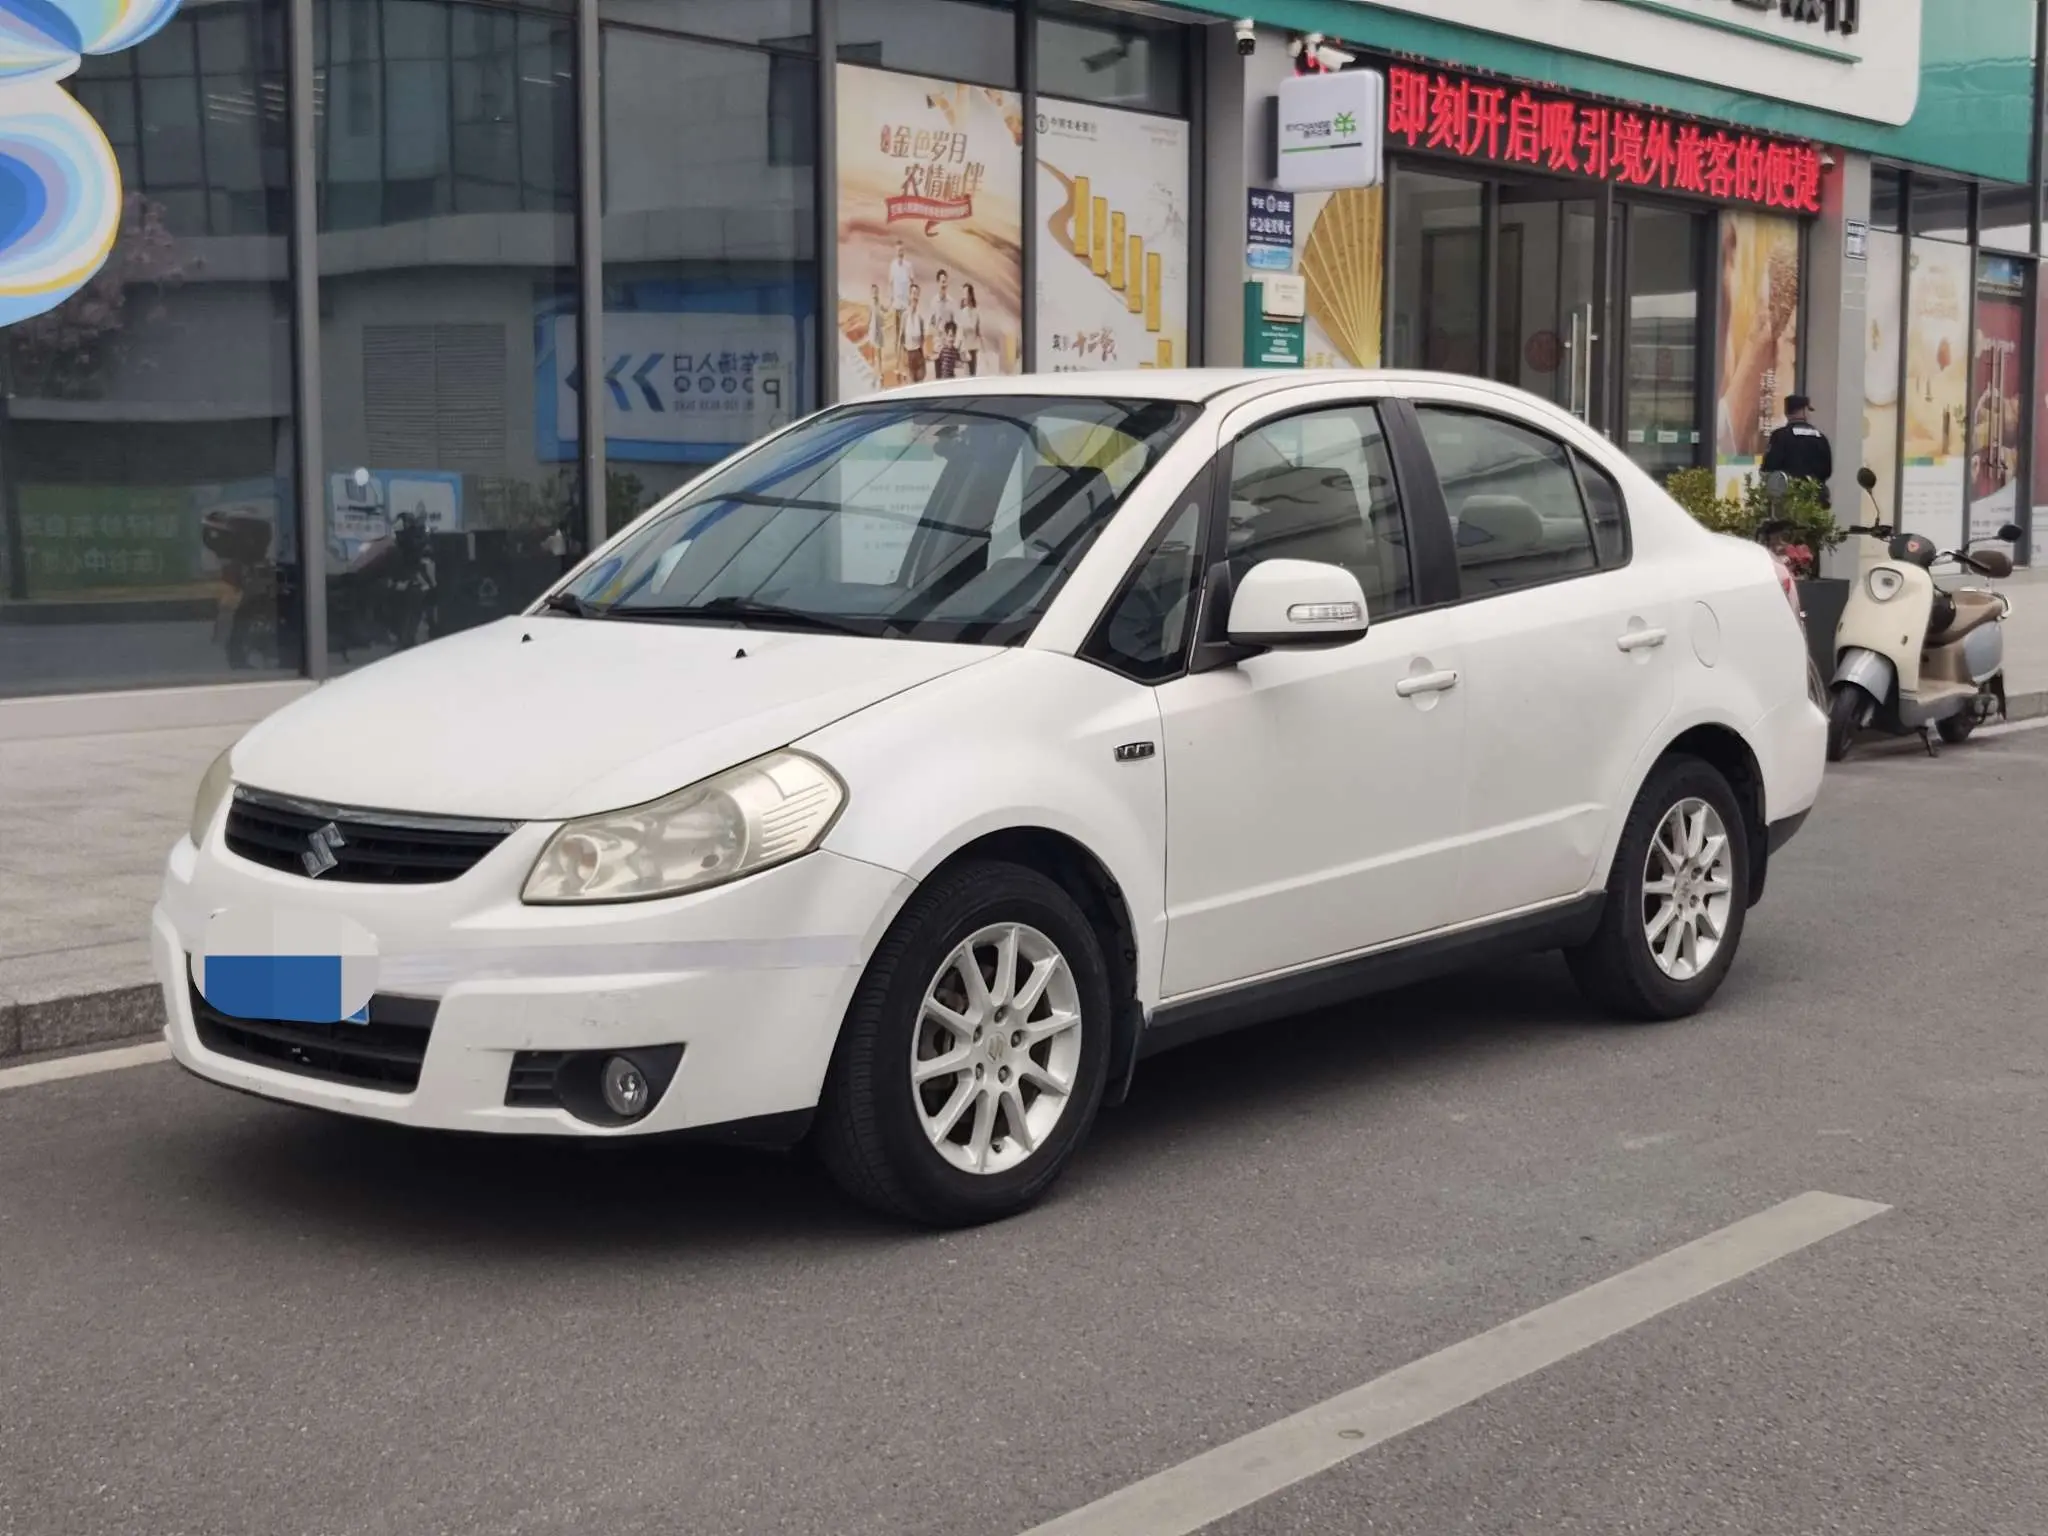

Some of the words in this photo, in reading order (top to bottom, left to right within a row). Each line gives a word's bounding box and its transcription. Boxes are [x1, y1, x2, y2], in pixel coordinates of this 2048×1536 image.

[890, 125, 967, 164] 金色岁月
[1388, 65, 1820, 212] 即刻开启吸引境外旅客的便捷
[901, 162, 985, 199] 农情相伴
